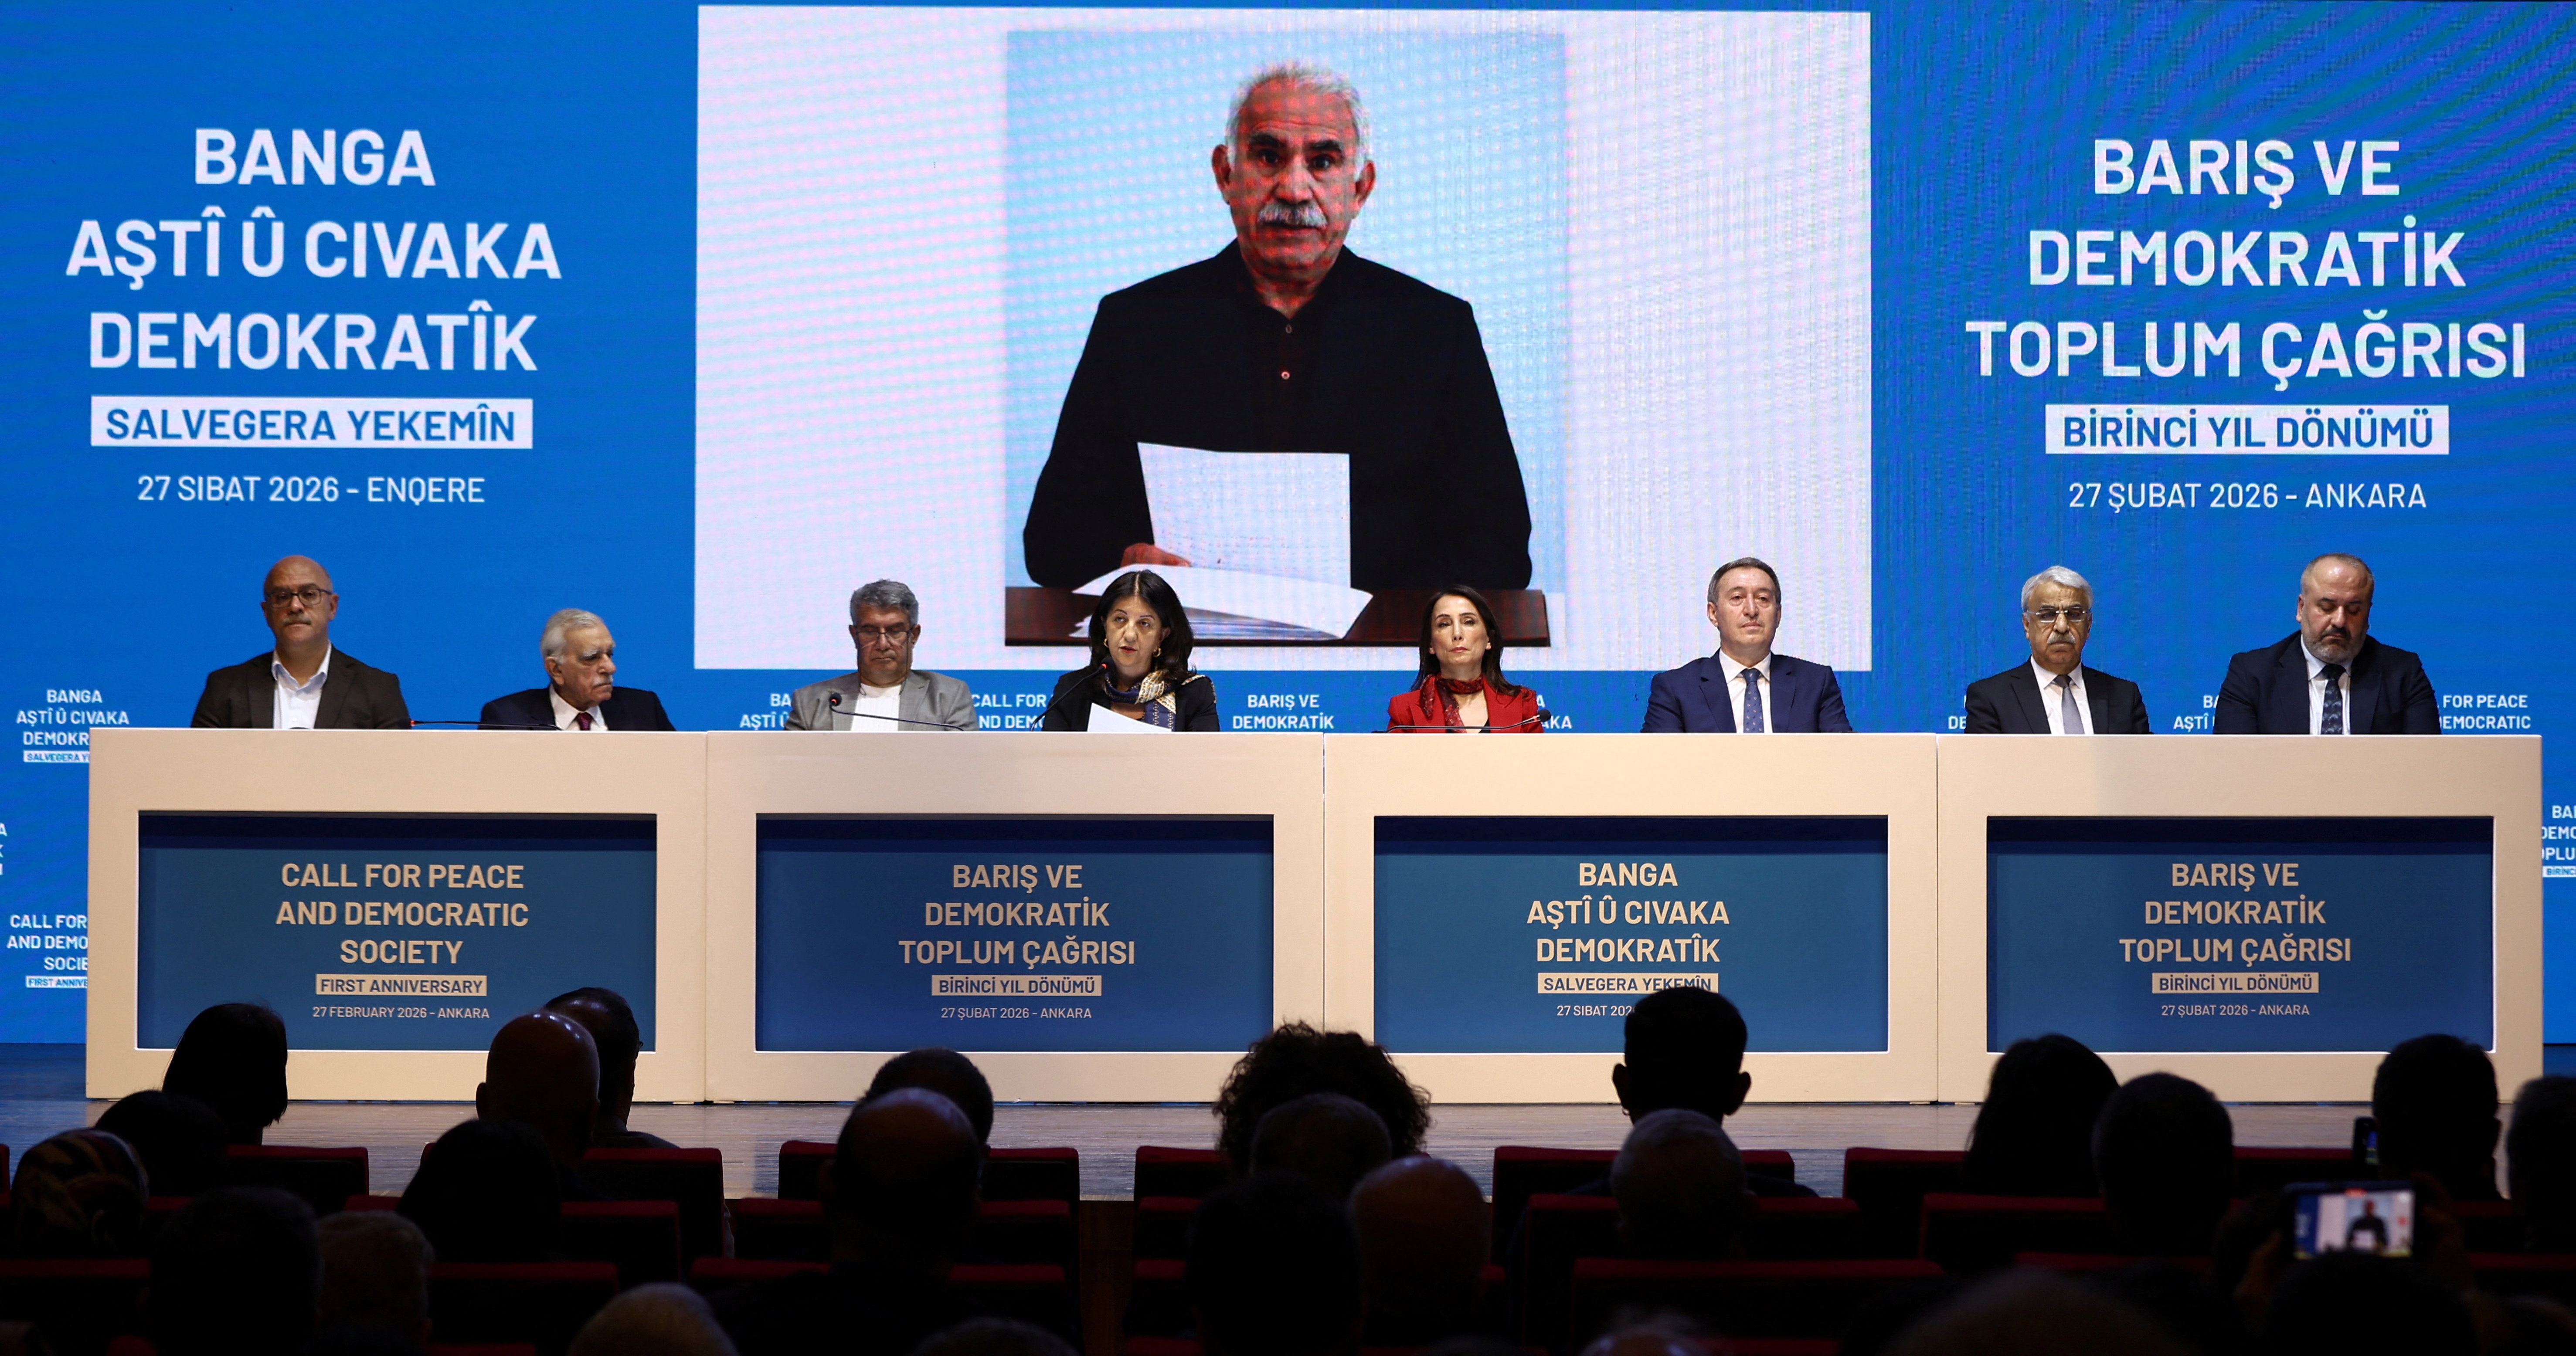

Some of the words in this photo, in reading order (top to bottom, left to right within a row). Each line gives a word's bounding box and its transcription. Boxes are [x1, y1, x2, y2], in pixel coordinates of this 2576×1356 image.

[196, 129, 435, 186] BANGA
[2095, 139, 2294, 209] BARIŞ
[2313, 141, 2399, 195] VE
[66, 206, 225, 290] AŞTÎ
[242, 207, 284, 277] Û
[306, 221, 561, 278] CIVAKA
[2030, 215, 2466, 286] DEMOKRATİK
[91, 300, 537, 370] DEMOKRATÎK
[1966, 321, 2240, 377] TOPLUM
[2262, 309, 2525, 391] ÇAĞRISI
[107, 409, 336, 440] SALVEGERA
[348, 403, 514, 441] YEKEMÎN
[2065, 408, 2196, 447] BİRİNCİ
[2208, 417, 2265, 447] YIL
[2277, 408, 2432, 448] DÖNÜMÜ
[138, 476, 170, 500] 27
[178, 476, 261, 501] SIBAT
[269, 477, 338, 501] 2026
[368, 477, 485, 505] ENQERE
[2070, 483, 2101, 507] 27
[2109, 483, 2201, 513] ŞUBAT
[2210, 483, 2278, 508] 2026
[2306, 484, 2426, 507] ANKARA
[47, 690, 102, 702] BANGA
[1016, 695, 1046, 707] FOR
[1248, 695, 1295, 710] BARIŞ
[1299, 695, 1319, 707] VE
[2443, 695, 2473, 708] FOR
[2477, 695, 2527, 708] PEACE
[17, 708, 53, 726] AŞTÎ
[56, 708, 66, 724] Û
[71, 711, 129, 724] CIVAKA
[1233, 712, 1334, 729] DEMOKRATİK
[2173, 713, 2209, 732] AŞTÎ
[282, 864, 357, 887] CALL
[366, 864, 421, 887] FOR
[429, 865, 523, 888] PEACE
[954, 865, 1037, 893] BARIŞ
[1046, 865, 1082, 888] VE
[1580, 863, 1678, 886] BANGA
[2172, 863, 2255, 892] BARIŞ
[2263, 863, 2298, 886] VE
[276, 902, 336, 924] AND
[345, 902, 528, 926] DEMOCRATIC
[926, 896, 1109, 926] DEMOKRATİK
[1527, 895, 1592, 929] AŞTÎ
[1599, 895, 1616, 924] Û
[1625, 901, 1729, 924] CIVAKA
[2146, 895, 2325, 924] DEMOKRATİK
[10, 915, 52, 928] CALL
[56, 915, 87, 929] FOR
[7, 936, 41, 948] AND
[341, 940, 463, 963] SOCIETY
[899, 941, 1014, 963] TOPLUM
[1023, 936, 1134, 969] ÇAĞRISI
[1537, 933, 1720, 962] DEMOKRATÎK
[2119, 939, 2232, 962] TOPLUM
[2241, 933, 2350, 967] ÇAĞRISI
[321, 979, 365, 992] FIRST
[370, 980, 482, 993] ANNIVERSARY
[940, 976, 995, 993] BİRİNCİ
[1000, 980, 1024, 993] YIL
[1029, 976, 1094, 993] DÖNÜMÜ
[1544, 978, 1638, 990] SALVEGERA
[2160, 974, 2214, 990] BİRİNCİ
[2219, 978, 2243, 990] YIL
[2247, 974, 2311, 990] DÖNÜMÜ
[313, 1007, 327, 1017] 27
[330, 1007, 394, 1017] FEBRUARY
[398, 1007, 427, 1018] 2026
[438, 1008, 489, 1018] ANKARA
[941, 1008, 955, 1017] 27
[958, 1008, 997, 1020] ŞUBAT
[1001, 1008, 1029, 1018] 2026
[1040, 1008, 1091, 1018] ANKARA
[1557, 1006, 1570, 1015] 27
[1573, 1006, 1607, 1016] SIBAT
[1611, 1005, 1635, 1016] 202
[2162, 1005, 2175, 1015] 27
[2178, 1005, 2216, 1017] ŞUBAT
[2220, 1005, 2248, 1015] 2026
[2259, 1005, 2309, 1015] ANKARA
